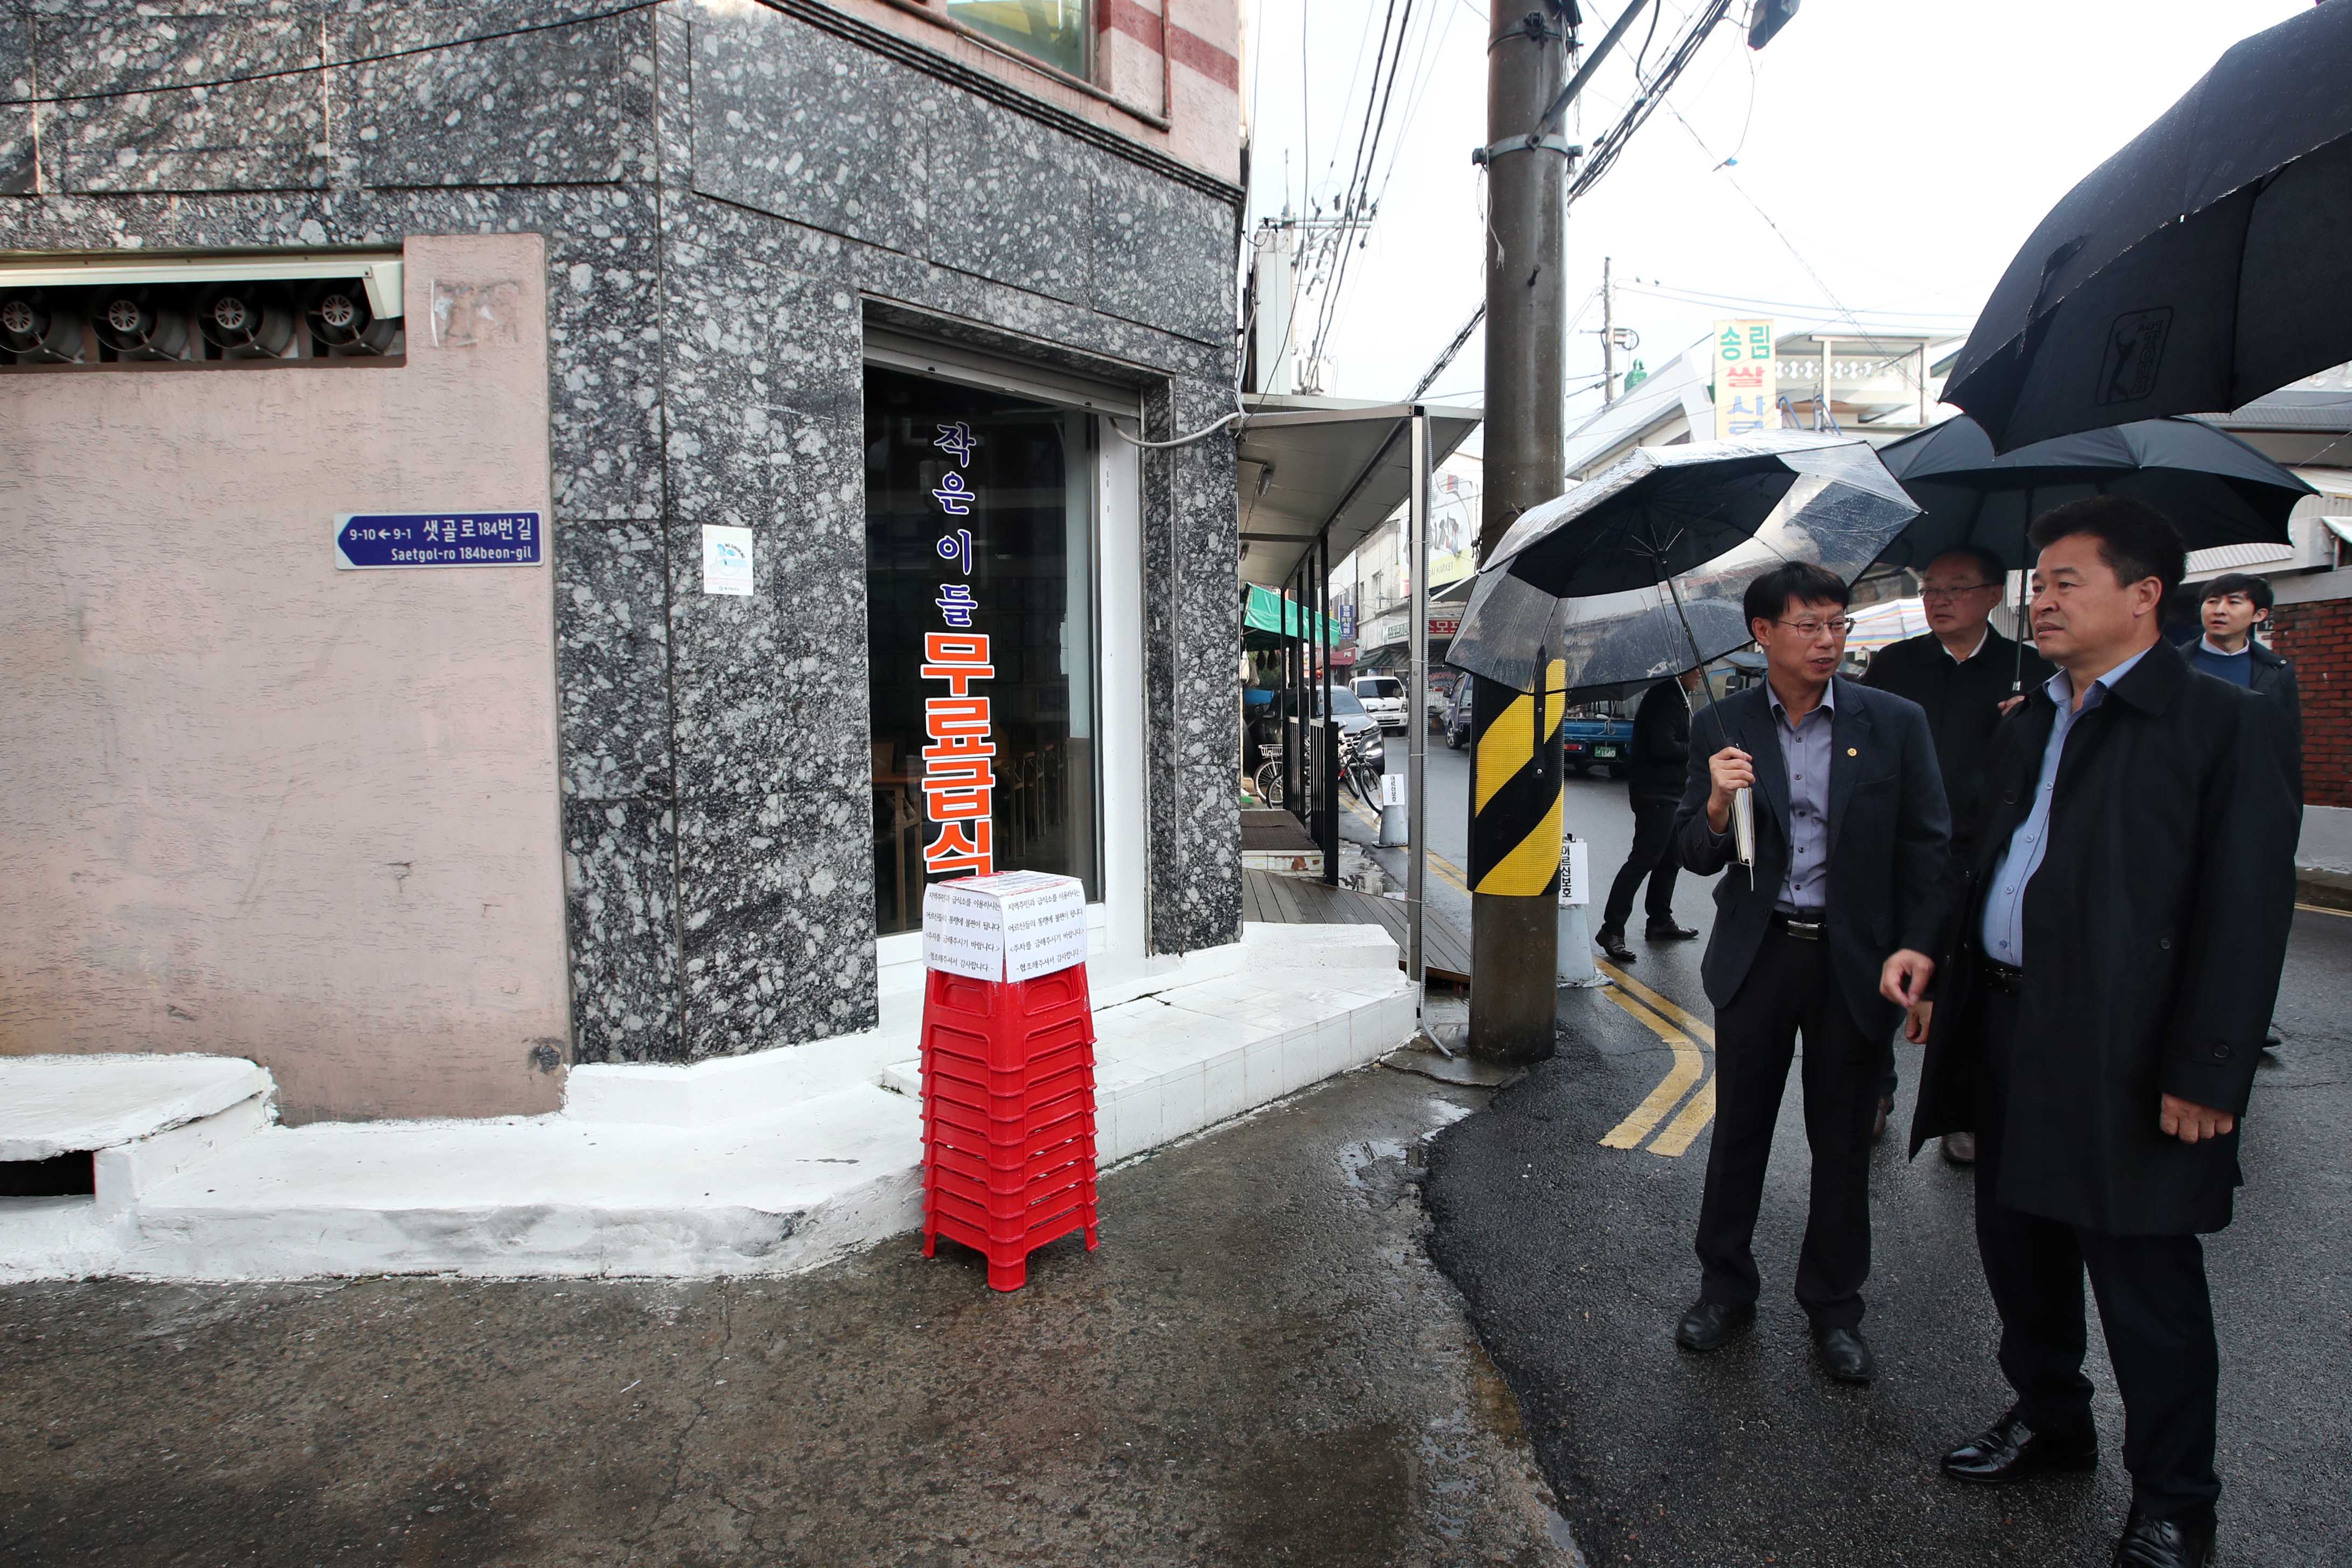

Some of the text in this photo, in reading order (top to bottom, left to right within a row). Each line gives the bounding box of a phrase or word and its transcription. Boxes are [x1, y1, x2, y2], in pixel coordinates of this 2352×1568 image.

[1720, 325, 1770, 360] 송림
[1726, 366, 1765, 387] 쌀
[349, 529, 375, 540] 9-10
[394, 529, 411, 540] 9-1
[391, 546, 531, 562] Saetgol-ro 184beon-gil
[921, 632, 996, 876] 무료급식
[952, 896, 971, 907] 급식소를
[1008, 899, 1035, 911] 지역주민과
[1037, 894, 1057, 905] 급식소를
